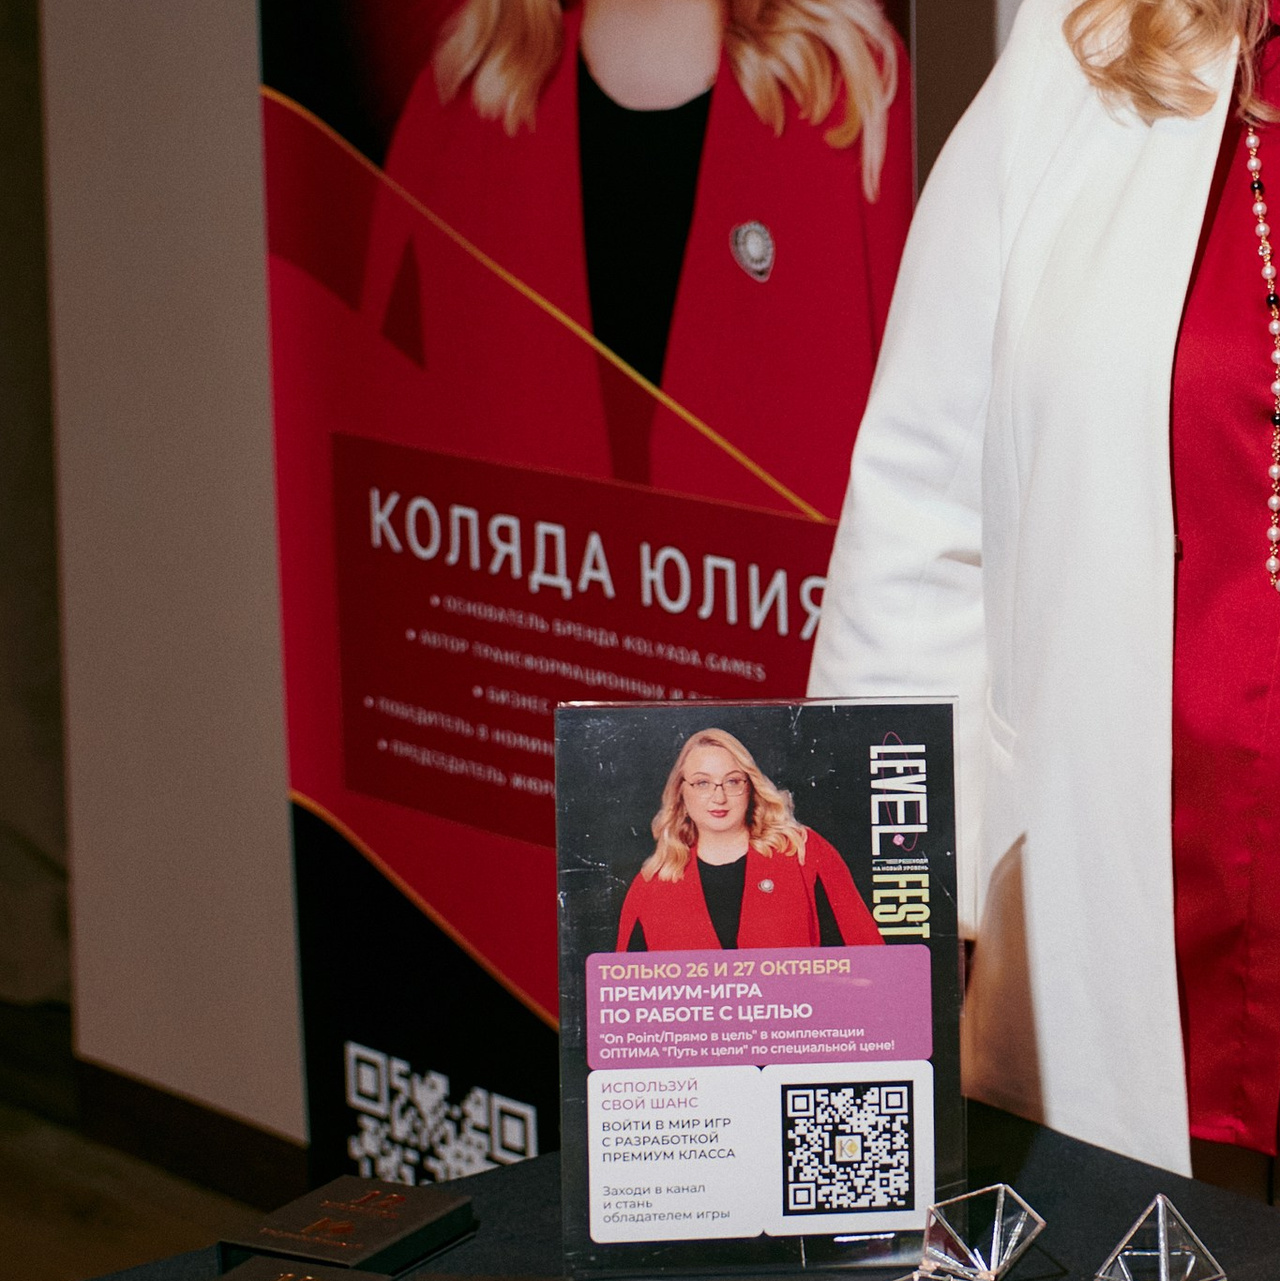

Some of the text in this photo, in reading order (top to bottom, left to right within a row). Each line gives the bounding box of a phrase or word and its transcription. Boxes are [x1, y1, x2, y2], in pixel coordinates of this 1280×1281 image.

[369, 486, 616, 601] КОЛЯДА
[442, 593, 551, 634] ОСНОВАТЕЛЬ
[551, 617, 620, 649] БРЕНДА
[418, 627, 470, 655] АВТОР
[869, 744, 929, 856] LEVEL
[872, 873, 931, 939] FEST
[598, 958, 851, 981] ТОЛЬКО 26 И 27 ОКТЯБРЯ
[600, 983, 763, 1002] ПРЕМИУМ-ИГРА
[600, 1003, 813, 1024] ПО РАБОТЕ С ЦЕЛЬЮ
[626, 1030, 708, 1045] Point/Прямо
[710, 1032, 719, 1042] в
[721, 1029, 758, 1043] цель"
[760, 1030, 768, 1040] в
[771, 1028, 865, 1040] комплектации
[600, 1039, 895, 1059] ОПТИМА "Путь к цели" по специальной цене!
[601, 1077, 698, 1094] ИСПОЛЬЗУЙ
[601, 1096, 699, 1111] СВОЙ ШАНС
[602, 1117, 732, 1132] ВОЙТИ В МИР ИГР
[602, 1131, 719, 1147] С РАЗРАБОТКОЙ
[602, 1148, 737, 1162] ПРЕМИУМ КЛАССА
[602, 1184, 706, 1197] Заходи в канал
[603, 1199, 653, 1210] и стань
[603, 1210, 731, 1224] обладателем игры
